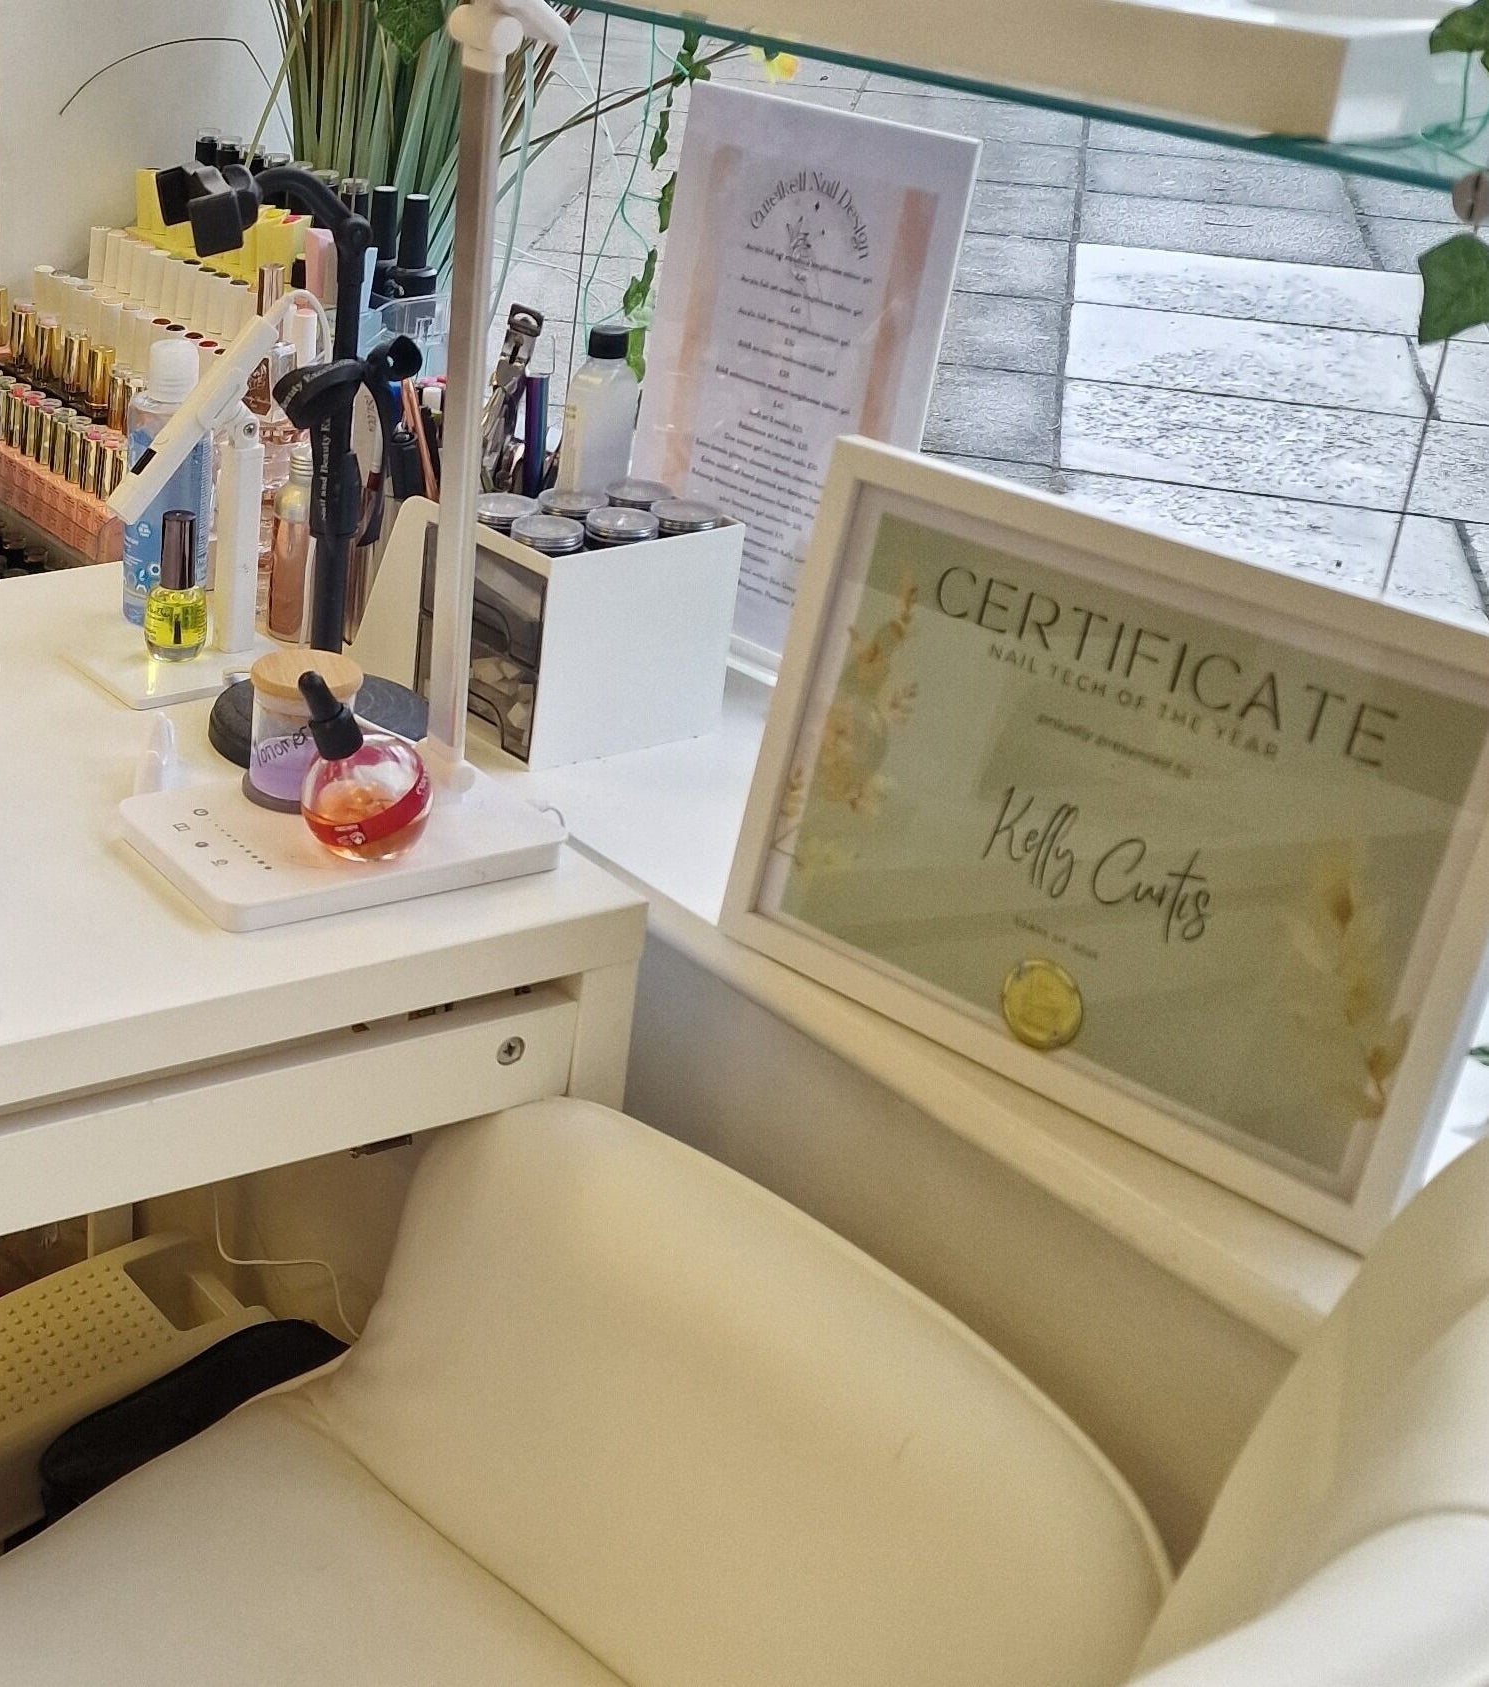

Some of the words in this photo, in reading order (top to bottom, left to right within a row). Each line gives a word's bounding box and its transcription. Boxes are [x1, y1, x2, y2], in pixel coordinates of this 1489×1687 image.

[811, 170, 841, 200] Nail
[837, 187, 869, 260] Design
[935, 565, 1400, 769] CERTIFICATE
[988, 641, 1038, 675] NAIL
[1048, 663, 1108, 699] TECH
[1118, 684, 1150, 712] OF
[1158, 702, 1203, 735] THE
[1213, 722, 1280, 758] YEAR
[982, 786, 1080, 899] Kelly
[1092, 838, 1212, 944] Curtis
